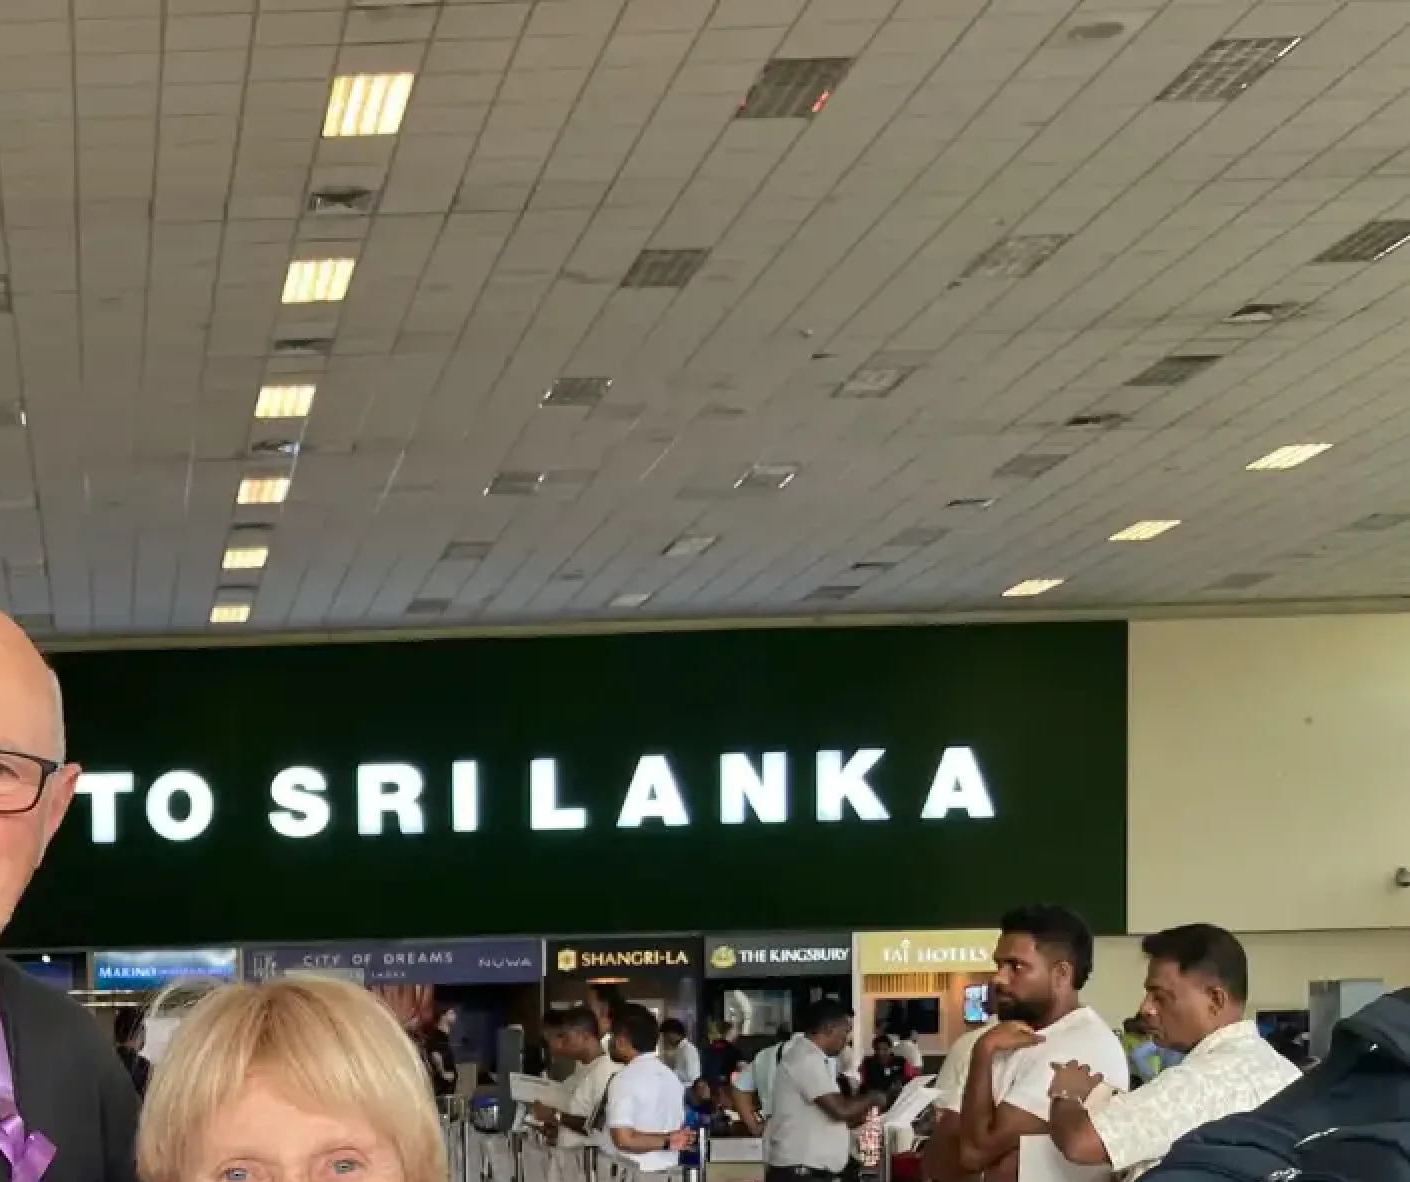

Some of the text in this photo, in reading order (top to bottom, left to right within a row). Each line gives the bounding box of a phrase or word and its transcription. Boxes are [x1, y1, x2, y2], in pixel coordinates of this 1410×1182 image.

[74, 769, 214, 843] TO
[268, 758, 478, 839] SRI
[529, 746, 996, 831] LANKA
[301, 951, 453, 968] CITY OF DREAMS
[581, 949, 689, 967] SHANGRI-LA
[738, 947, 851, 964] THE KINGSBURY
[917, 946, 988, 963] HOTELS
